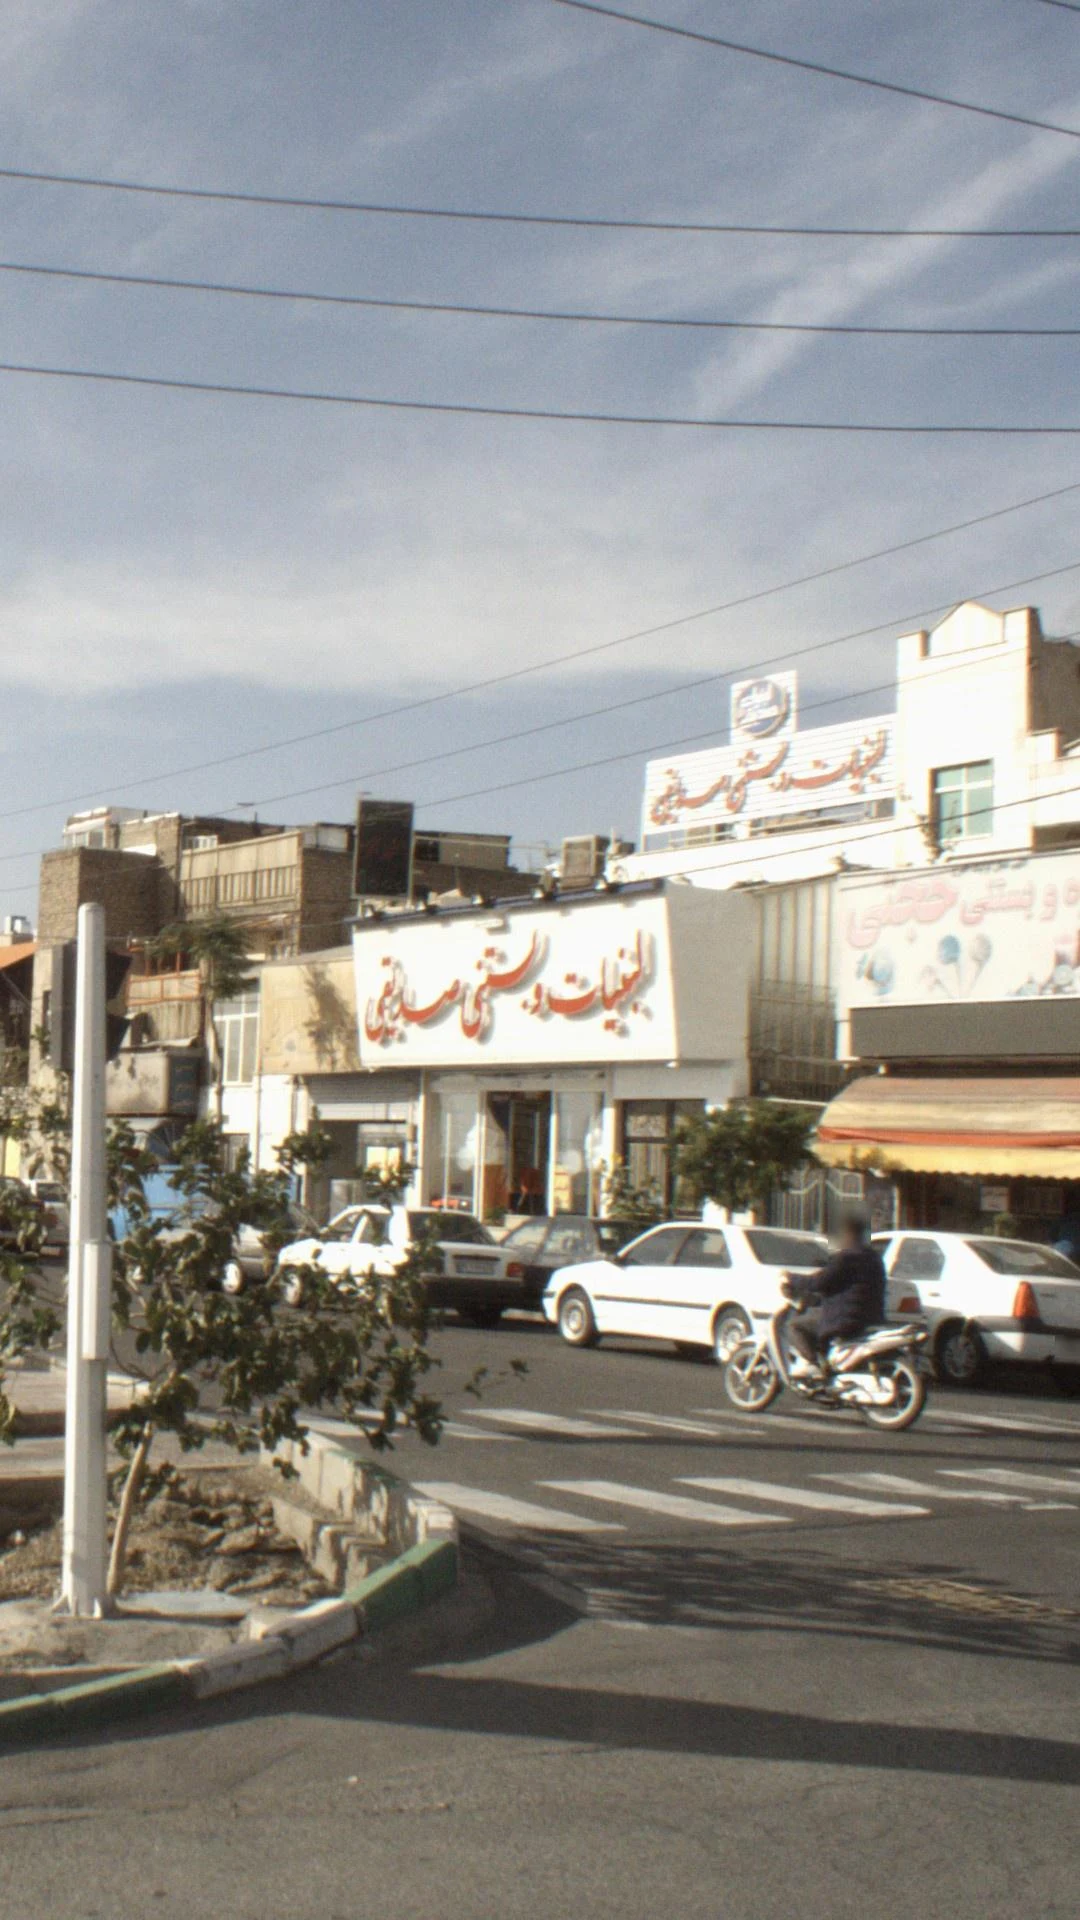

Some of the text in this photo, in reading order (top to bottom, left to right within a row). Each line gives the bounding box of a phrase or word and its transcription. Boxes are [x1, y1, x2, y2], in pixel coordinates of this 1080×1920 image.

[790, 729, 888, 793] لبنیات
[460, 929, 541, 1039] بستنی
[547, 928, 647, 1032] لبنیات
